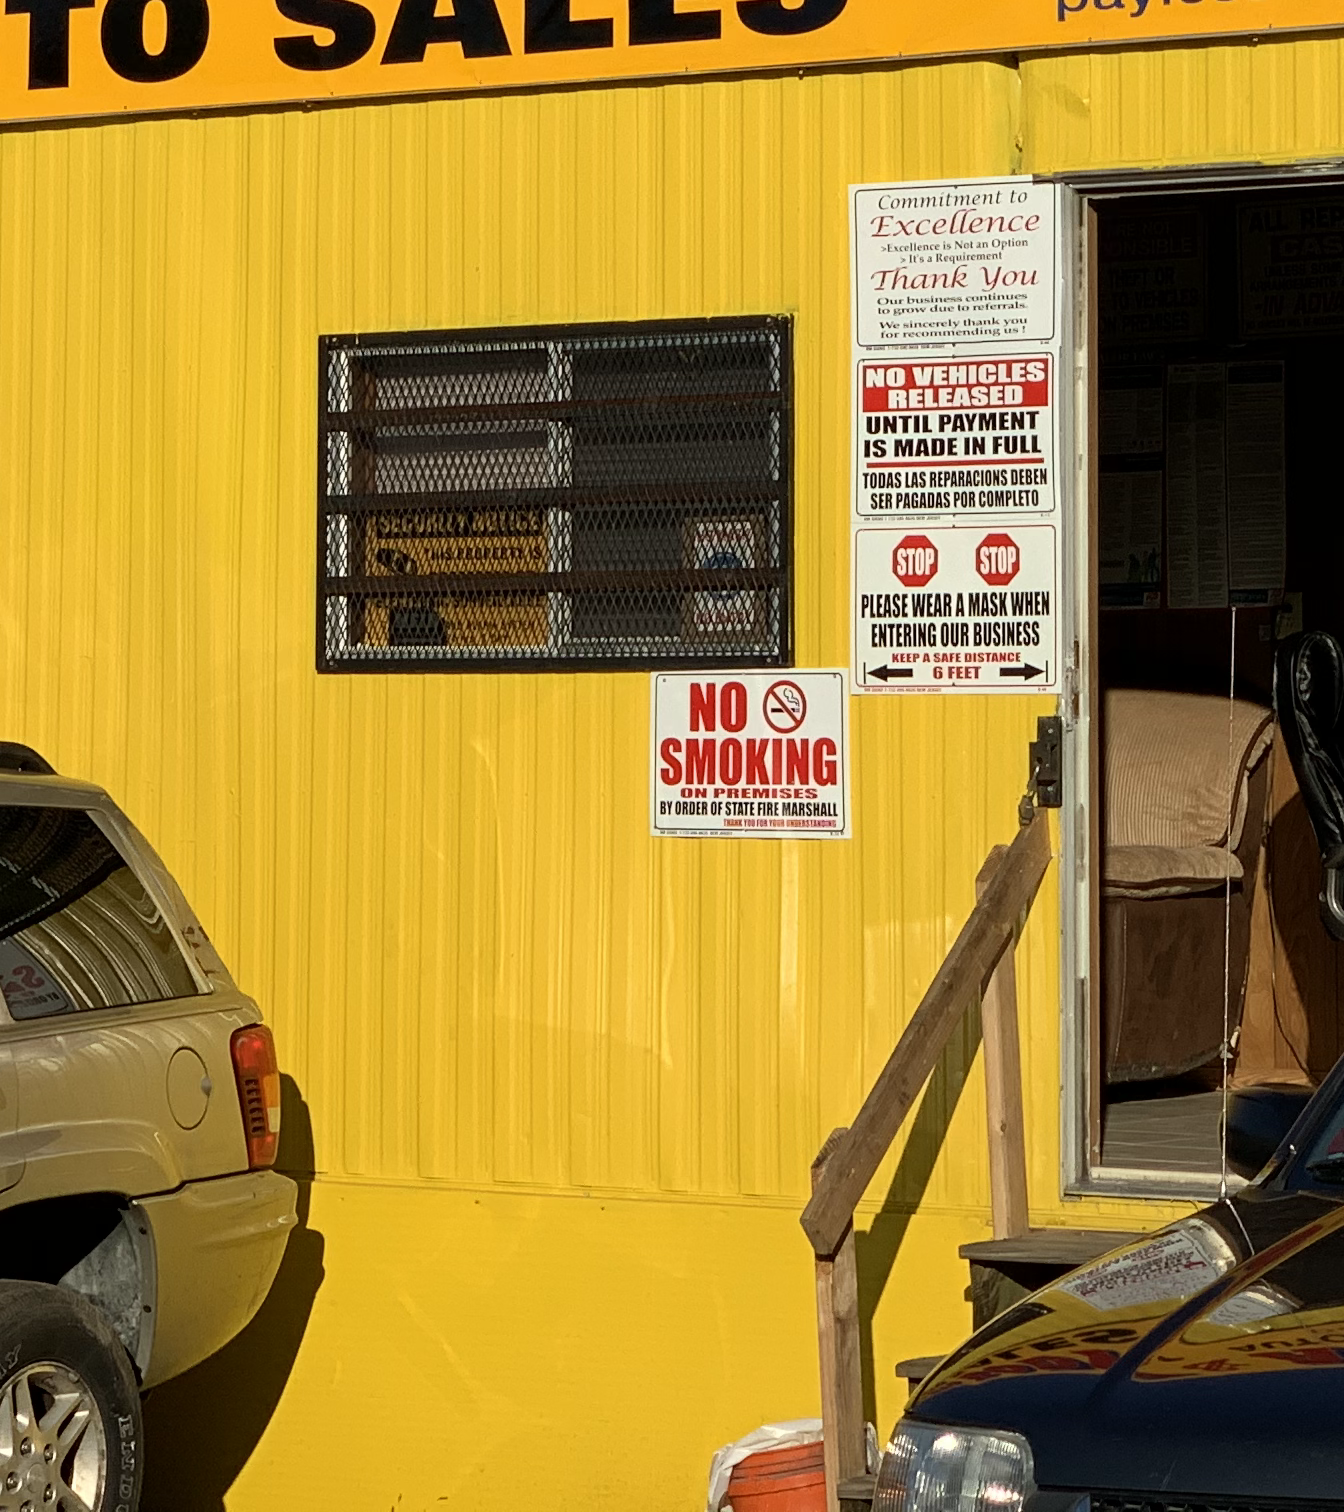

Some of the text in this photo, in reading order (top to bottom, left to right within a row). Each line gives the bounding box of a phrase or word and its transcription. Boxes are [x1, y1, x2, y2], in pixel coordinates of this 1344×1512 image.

[878, 190, 1028, 211] Commitment to
[870, 208, 1040, 237] Excellence
[1248, 209, 1289, 233] ALL
[943, 241, 951, 251] is
[955, 240, 974, 250] Not
[991, 238, 1028, 250] Option
[909, 254, 924, 264] It's
[936, 252, 1003, 264] Requirement
[870, 264, 1040, 292] Thank You
[877, 292, 1028, 306] Our business continues
[878, 307, 891, 315] to
[893, 306, 926, 317] grow
[929, 304, 954, 313] due
[957, 304, 970, 312] to
[879, 317, 1028, 329] We sincerely thank you
[880, 329, 900, 339] for
[902, 326, 1001, 338] recommending
[1003, 326, 1019, 334] us
[865, 361, 1046, 388] NO VEHICLES
[887, 385, 1024, 409] RELEASED
[866, 411, 1040, 435] UNTIL PAYMENT
[864, 434, 1042, 458] IS MADE IN FULL
[862, 468, 1047, 489] TODAS LAS REPARACIONS DEBEN
[870, 489, 1039, 510] SER PAGADAS POR COMPLETO
[896, 547, 935, 576] STOP
[979, 546, 1017, 575] STOP
[861, 590, 1050, 619] PLEASE WEAR A MASK WHEN
[871, 620, 1040, 648] ENTERING OUR BUSINESS
[891, 652, 1022, 663] KEEP A SAFE DISTANCE
[932, 666, 982, 680] 6 FEET
[689, 681, 748, 734] NO
[660, 737, 838, 787] SMOKING
[680, 787, 819, 799] ON PREMISES
[660, 801, 838, 817] BY ORDER OF STATE FIRE MARSHALL
[724, 818, 837, 828] THANK YOU FOR YOUR UNDERSTANDING
